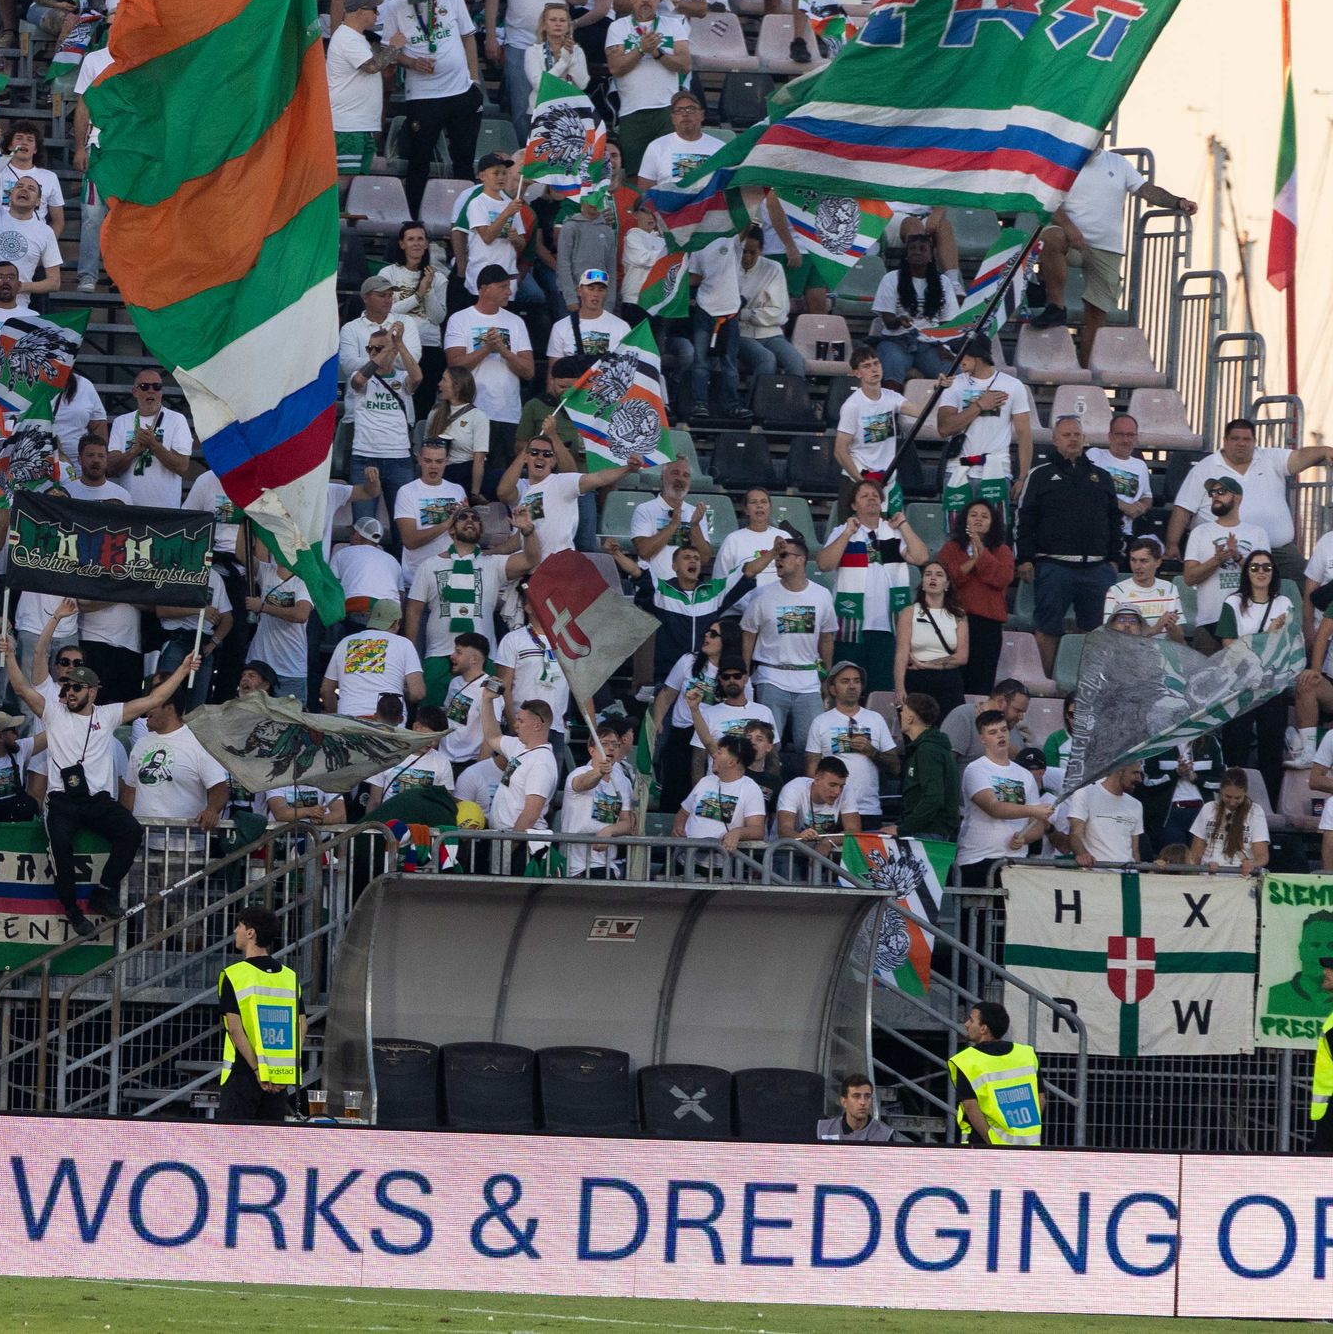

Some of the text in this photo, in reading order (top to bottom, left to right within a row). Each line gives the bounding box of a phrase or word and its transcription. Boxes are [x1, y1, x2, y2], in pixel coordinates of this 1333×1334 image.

[11, 546, 78, 574] Söhne
[110, 559, 210, 589] Hauptstadt
[1054, 888, 1213, 928] H X
[262, 1027, 286, 1045] 284
[1052, 998, 1213, 1036] R W
[11, 1156, 433, 1256] WORKS
[470, 1173, 540, 1260] &
[576, 1177, 1181, 1278] DREDGING
